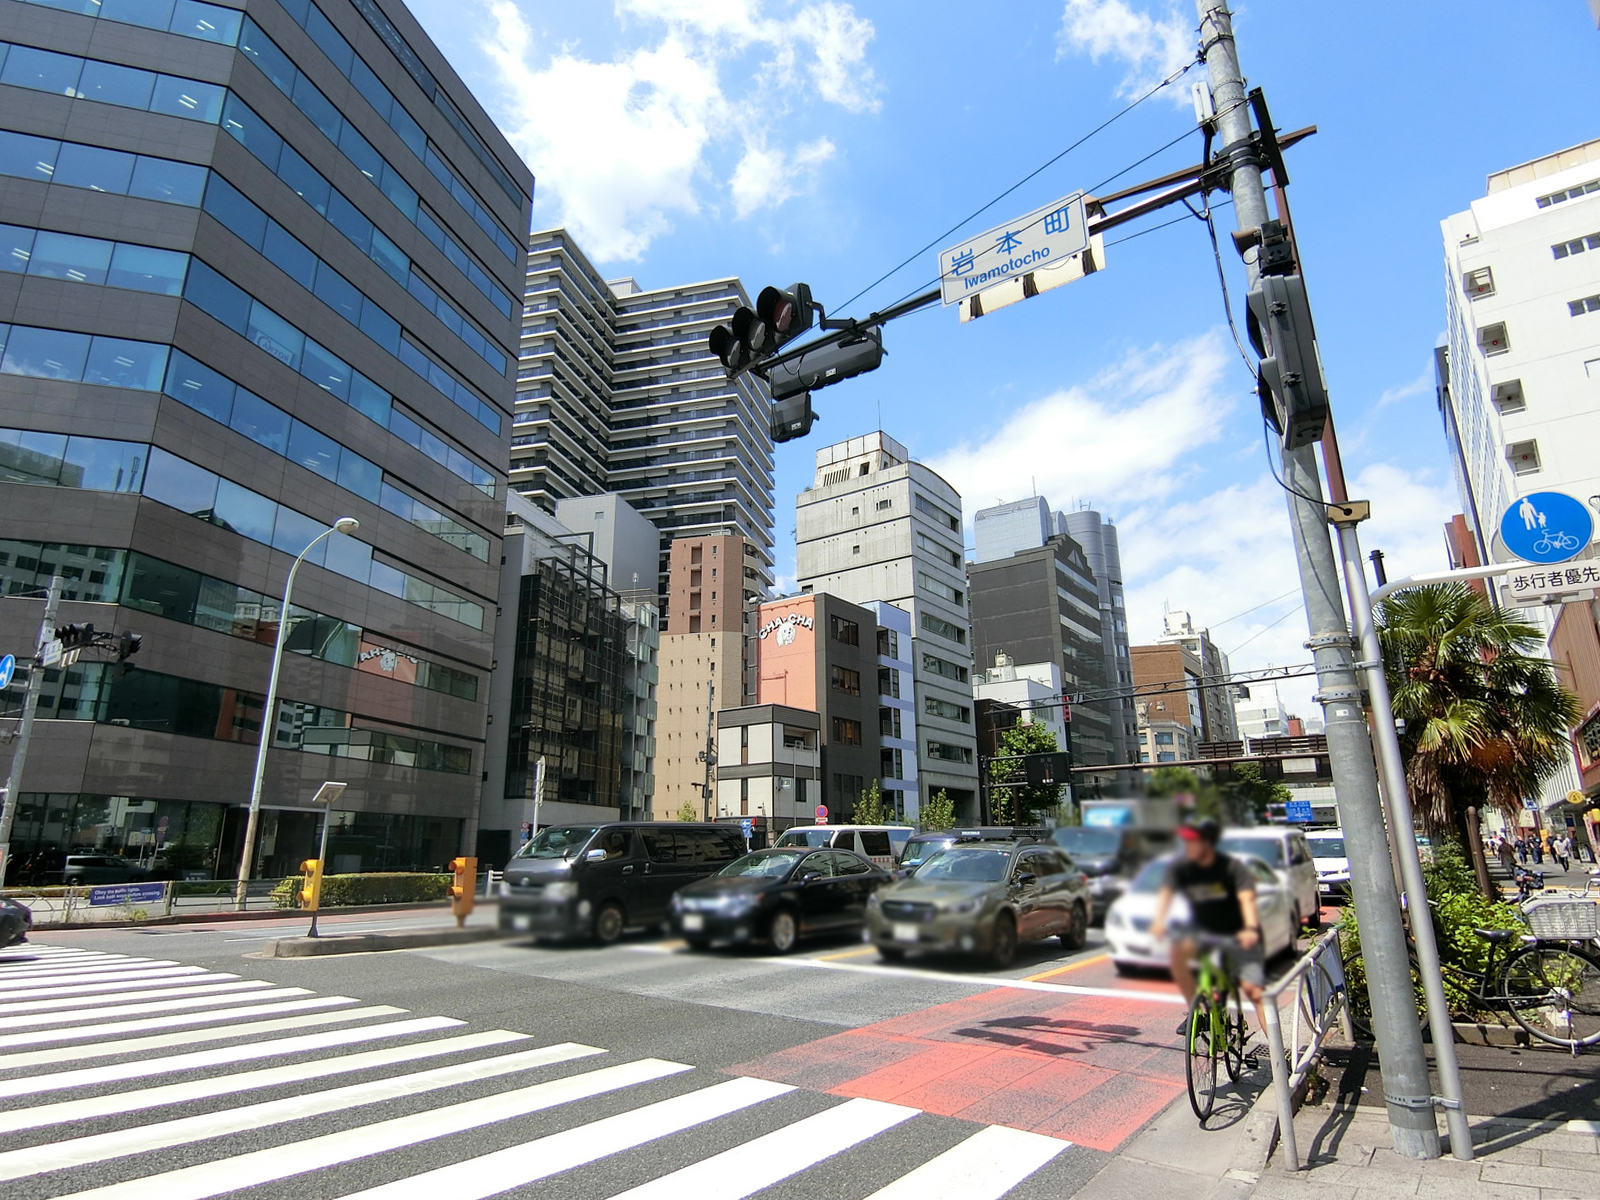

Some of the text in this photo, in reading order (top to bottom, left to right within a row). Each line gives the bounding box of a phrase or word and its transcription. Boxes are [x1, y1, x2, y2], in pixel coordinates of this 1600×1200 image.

[951, 206, 1070, 277] 岩本町
[964, 247, 1051, 290] Iwamotocho
[1513, 566, 1600, 592] 歩行者優先
